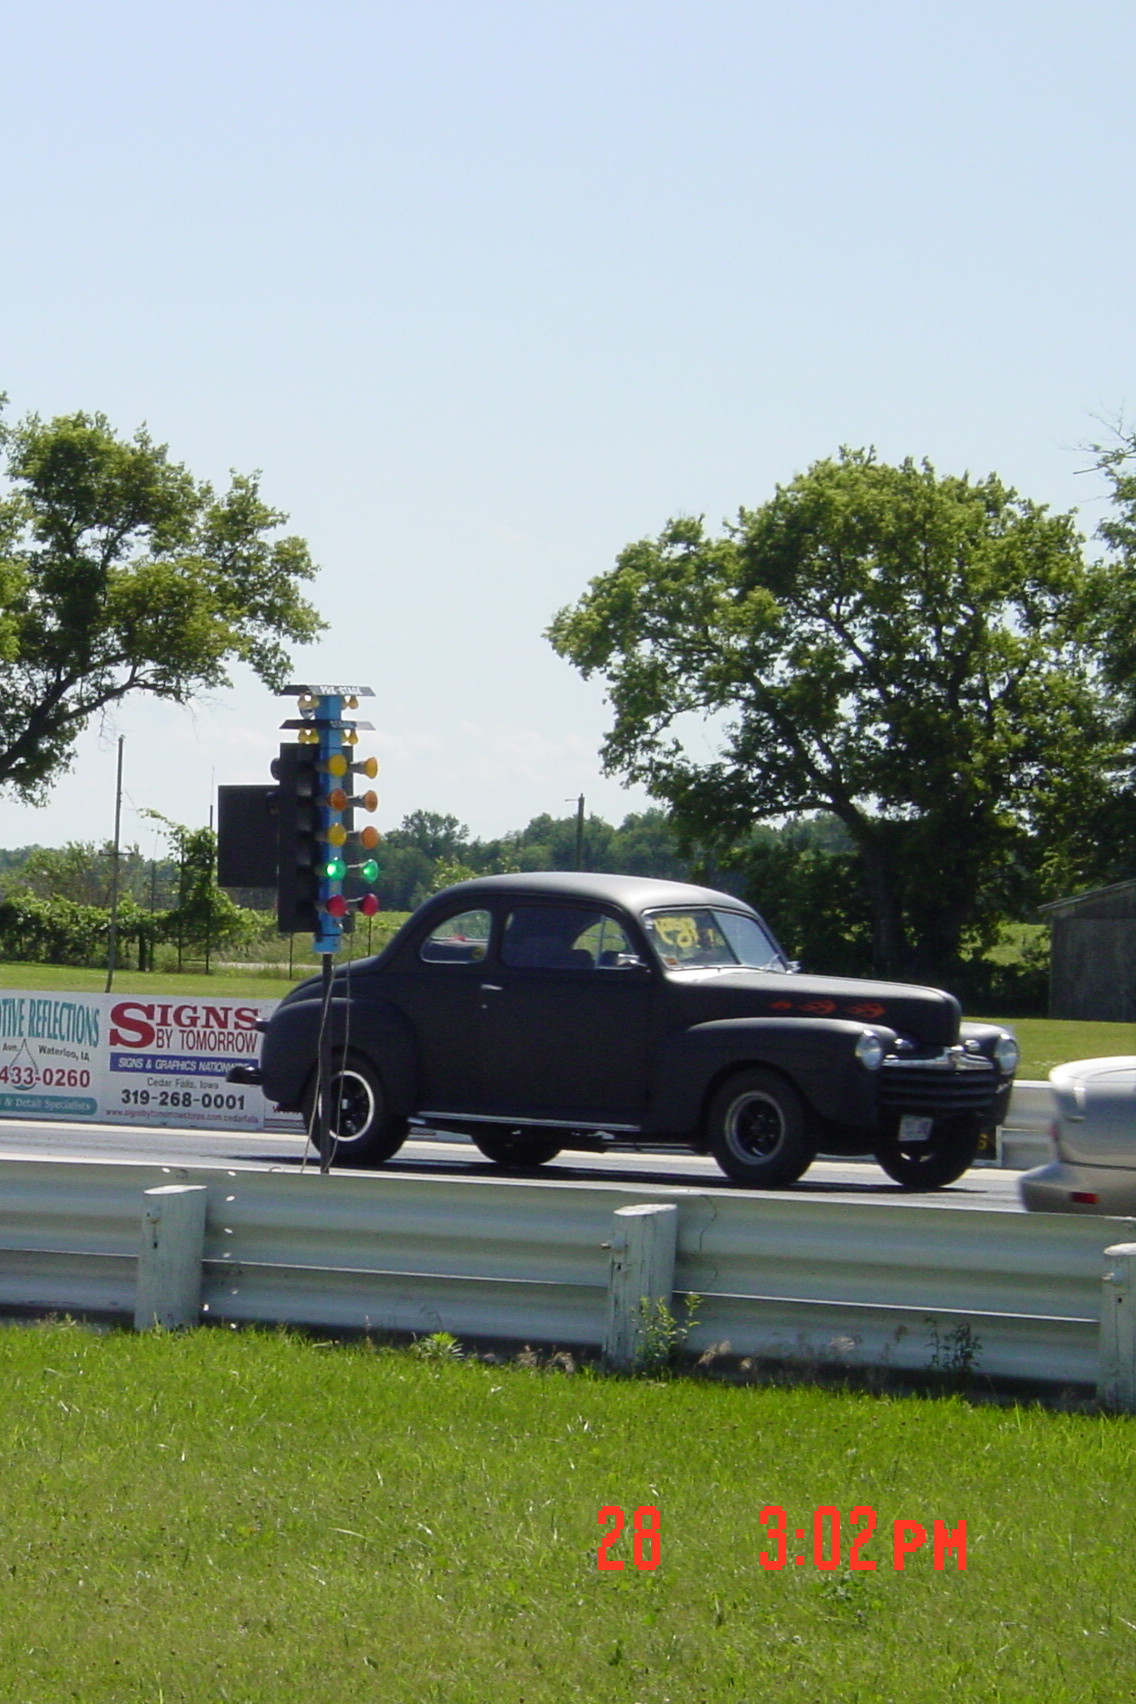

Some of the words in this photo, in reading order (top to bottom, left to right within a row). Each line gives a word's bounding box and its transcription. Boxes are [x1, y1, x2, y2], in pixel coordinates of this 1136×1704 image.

[28, 998, 100, 1048] REFLECTIONS
[108, 1002, 259, 1049] SIGNS
[156, 1030, 172, 1049] BY
[179, 1030, 258, 1053] TOMORROW
[38, 1045, 79, 1060] Waterloo,
[80, 1051, 91, 1062] IA
[118, 1057, 144, 1068] SIGNS
[145, 1058, 153, 1069] &
[155, 1059, 197, 1071] GRAPHICS
[147, 1077, 172, 1088] Cedar
[199, 1080, 219, 1090] Iowa
[121, 1089, 246, 1110] 319-268-0001
